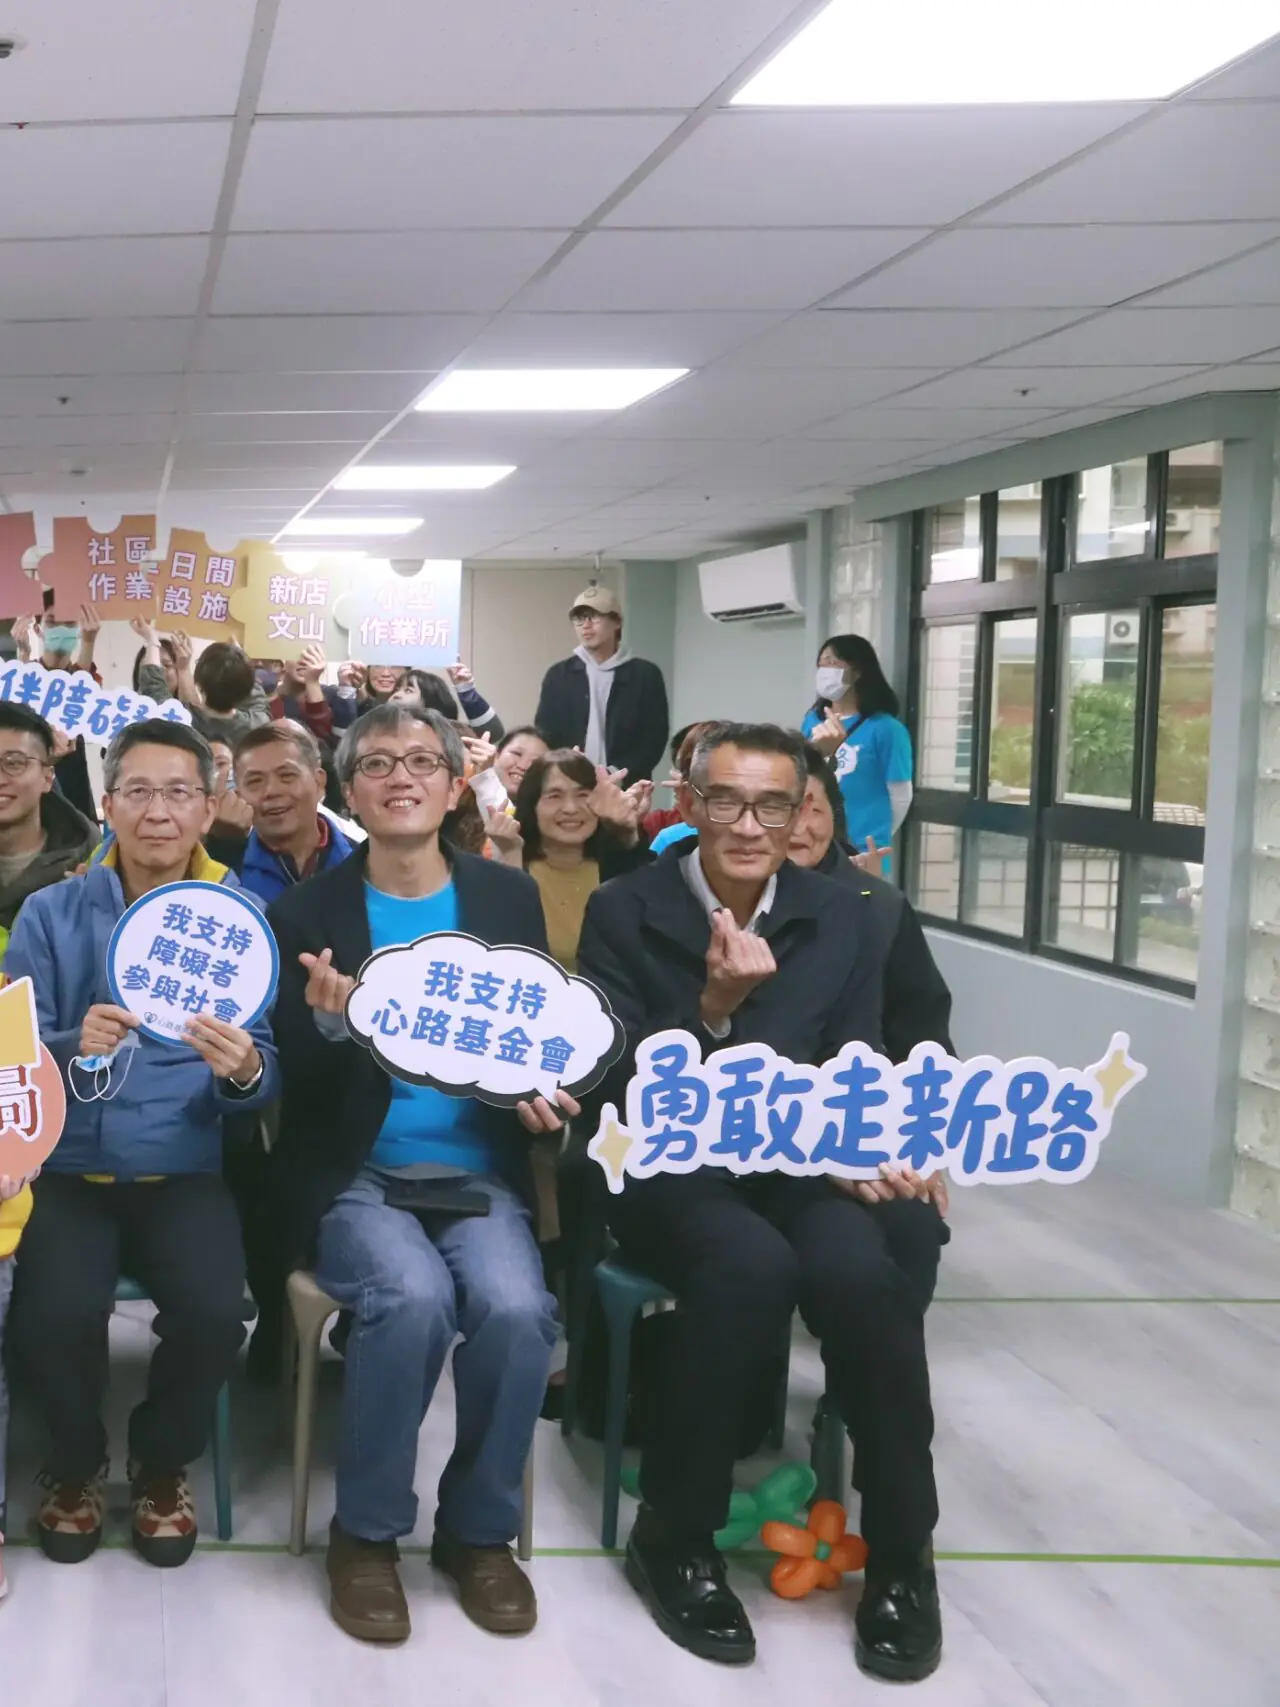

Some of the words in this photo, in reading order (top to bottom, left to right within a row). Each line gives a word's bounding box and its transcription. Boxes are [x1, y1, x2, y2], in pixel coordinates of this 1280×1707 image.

[88, 536, 151, 565] 社區
[88, 572, 152, 601] 作業
[171, 552, 235, 587] 日間
[163, 586, 229, 622] 設施
[269, 576, 329, 606] 新店
[268, 611, 324, 641] 文山
[360, 616, 450, 647] 作業所
[163, 903, 253, 956] 我支持
[147, 935, 239, 988] 障礙者
[122, 964, 242, 1024] 參與社會
[424, 961, 548, 1022] 我支持
[370, 998, 576, 1075] 心路基金會
[640, 1043, 1099, 1174] 勇敢走新路
